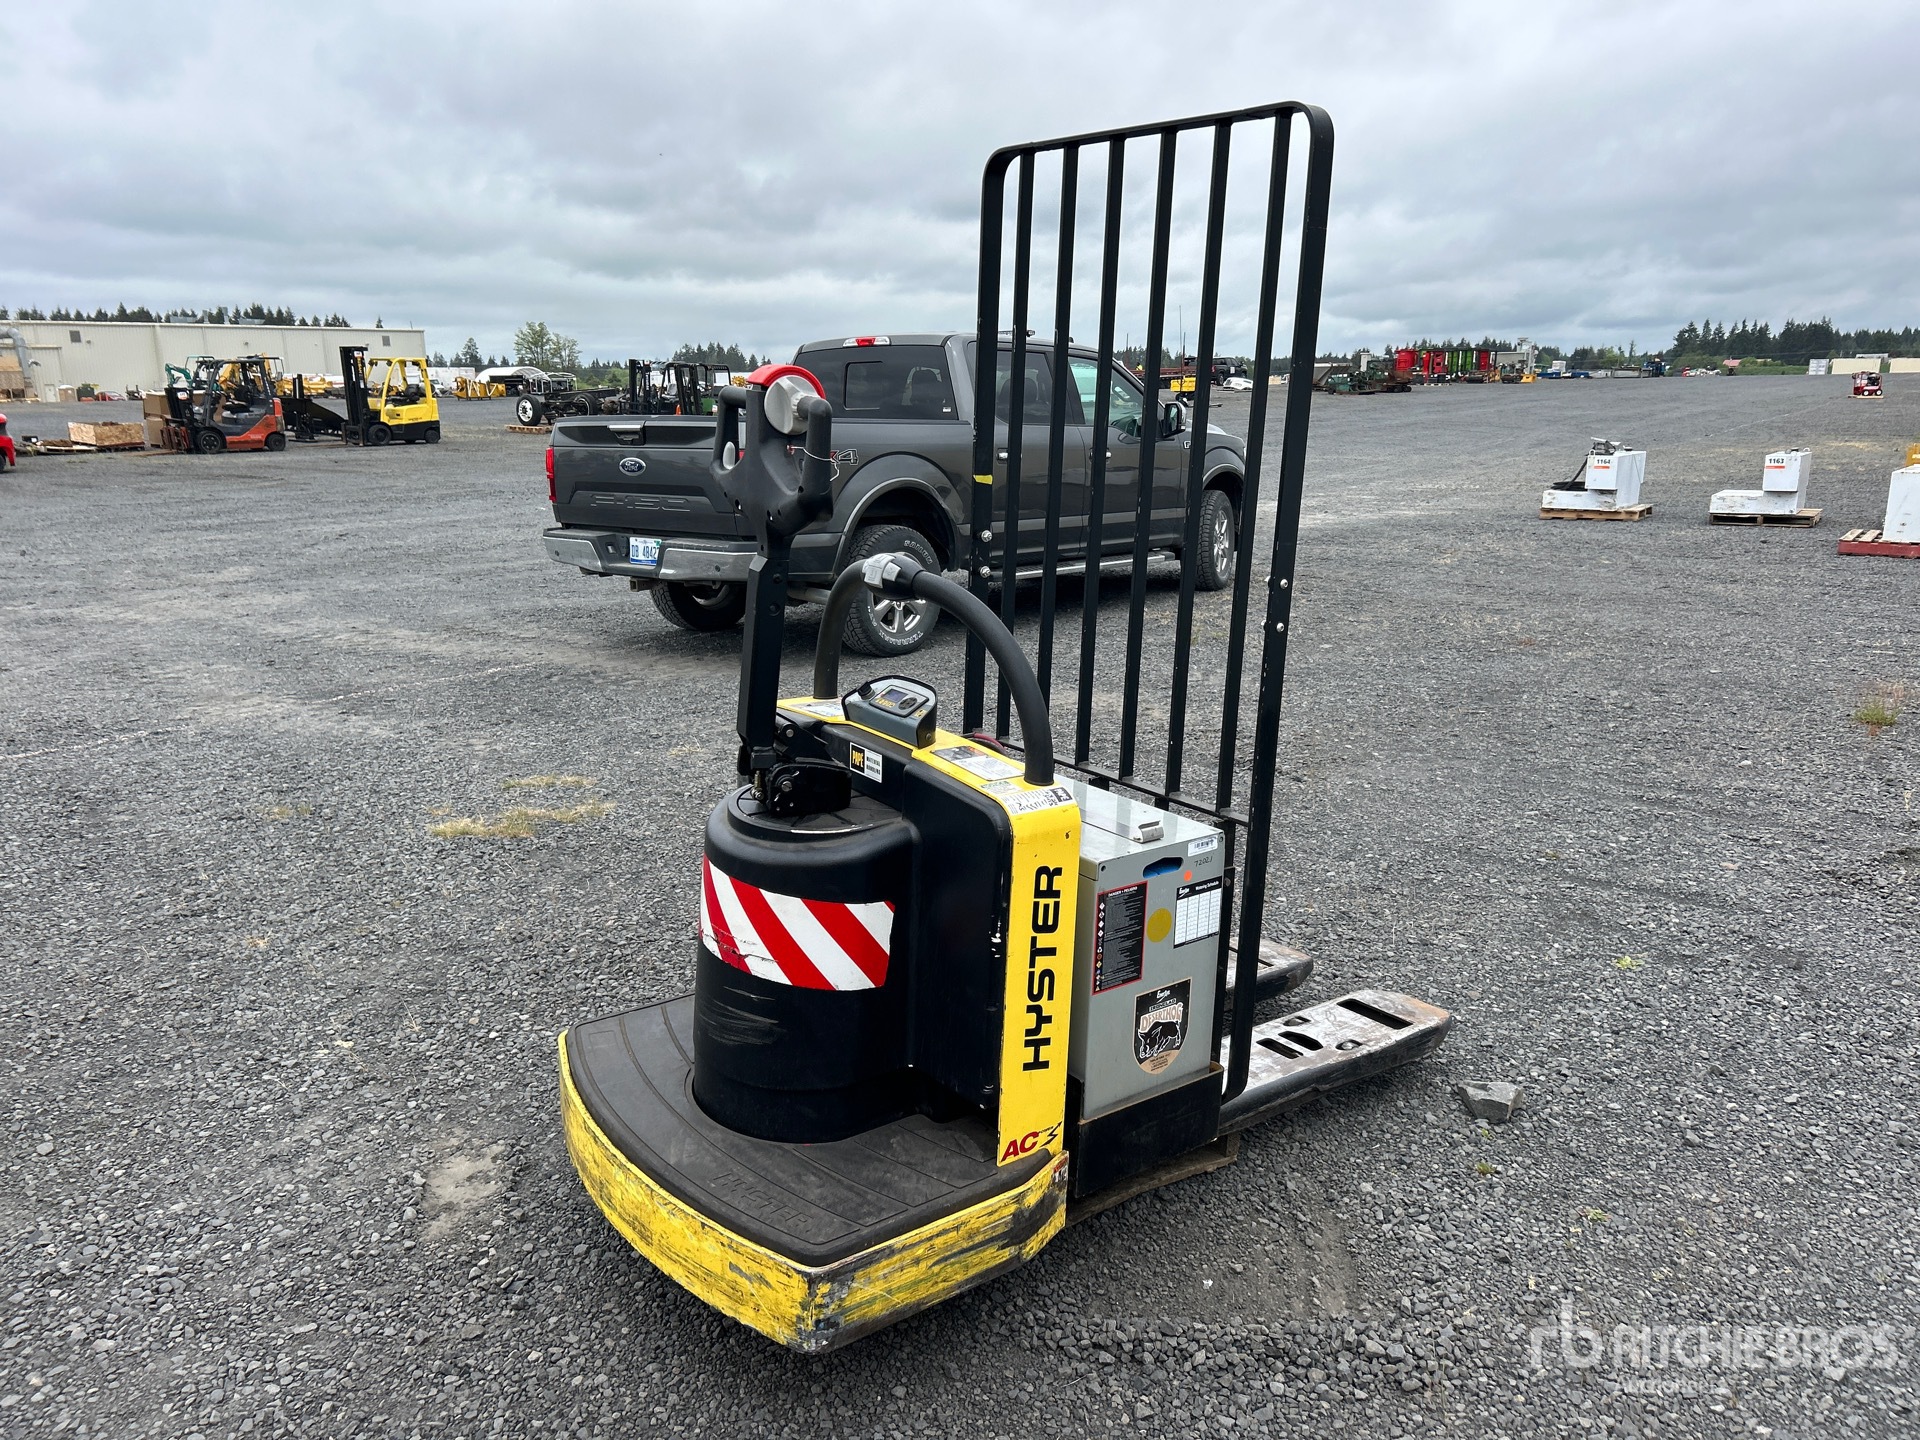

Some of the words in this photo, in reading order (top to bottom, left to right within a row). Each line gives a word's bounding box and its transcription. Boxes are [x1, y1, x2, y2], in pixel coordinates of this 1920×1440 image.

[1022, 865, 1063, 1072] HYSTER
[1000, 1131, 1040, 1163] AC
[711, 1171, 816, 1234] HYSTER
